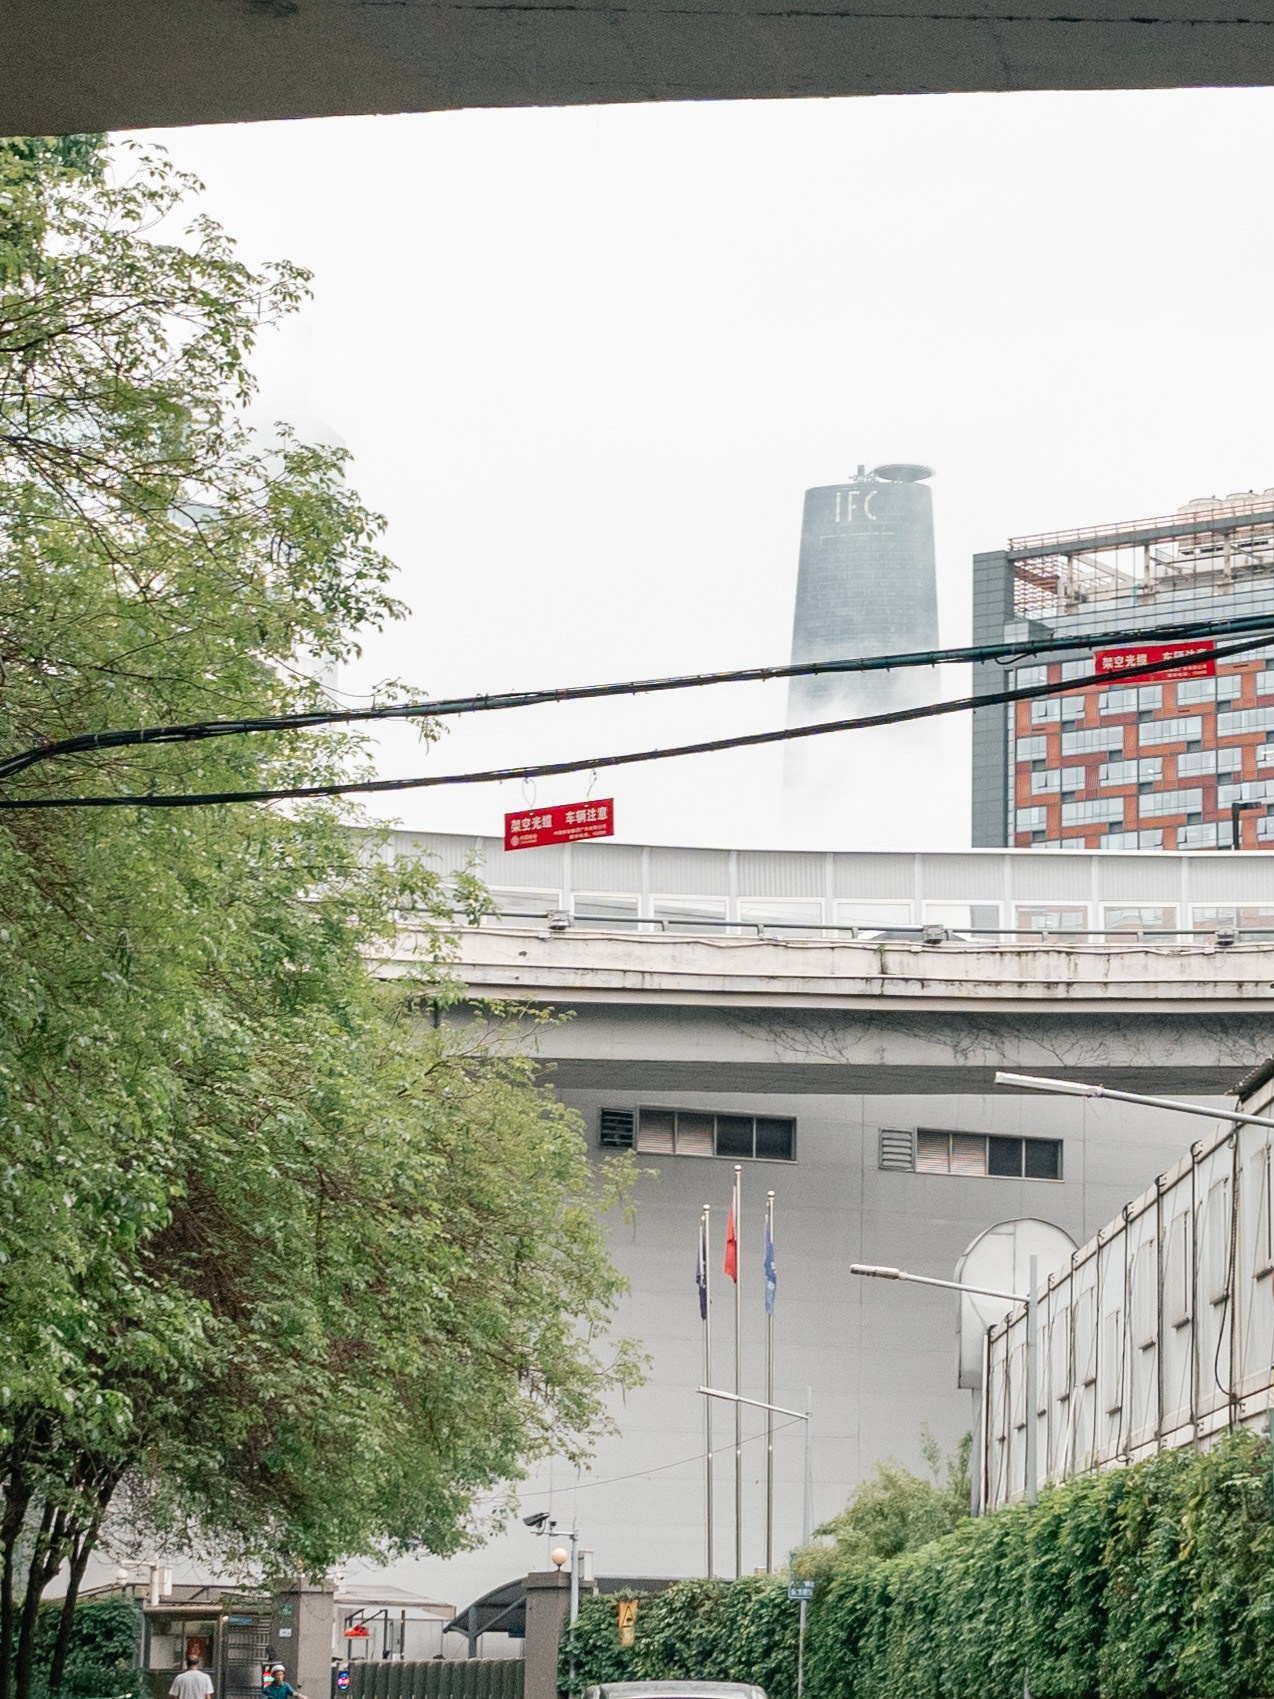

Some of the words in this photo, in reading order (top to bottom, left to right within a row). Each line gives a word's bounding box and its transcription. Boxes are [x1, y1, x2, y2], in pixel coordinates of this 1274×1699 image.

[835, 490, 878, 523] IFC
[565, 806, 608, 825] 车辆注意
